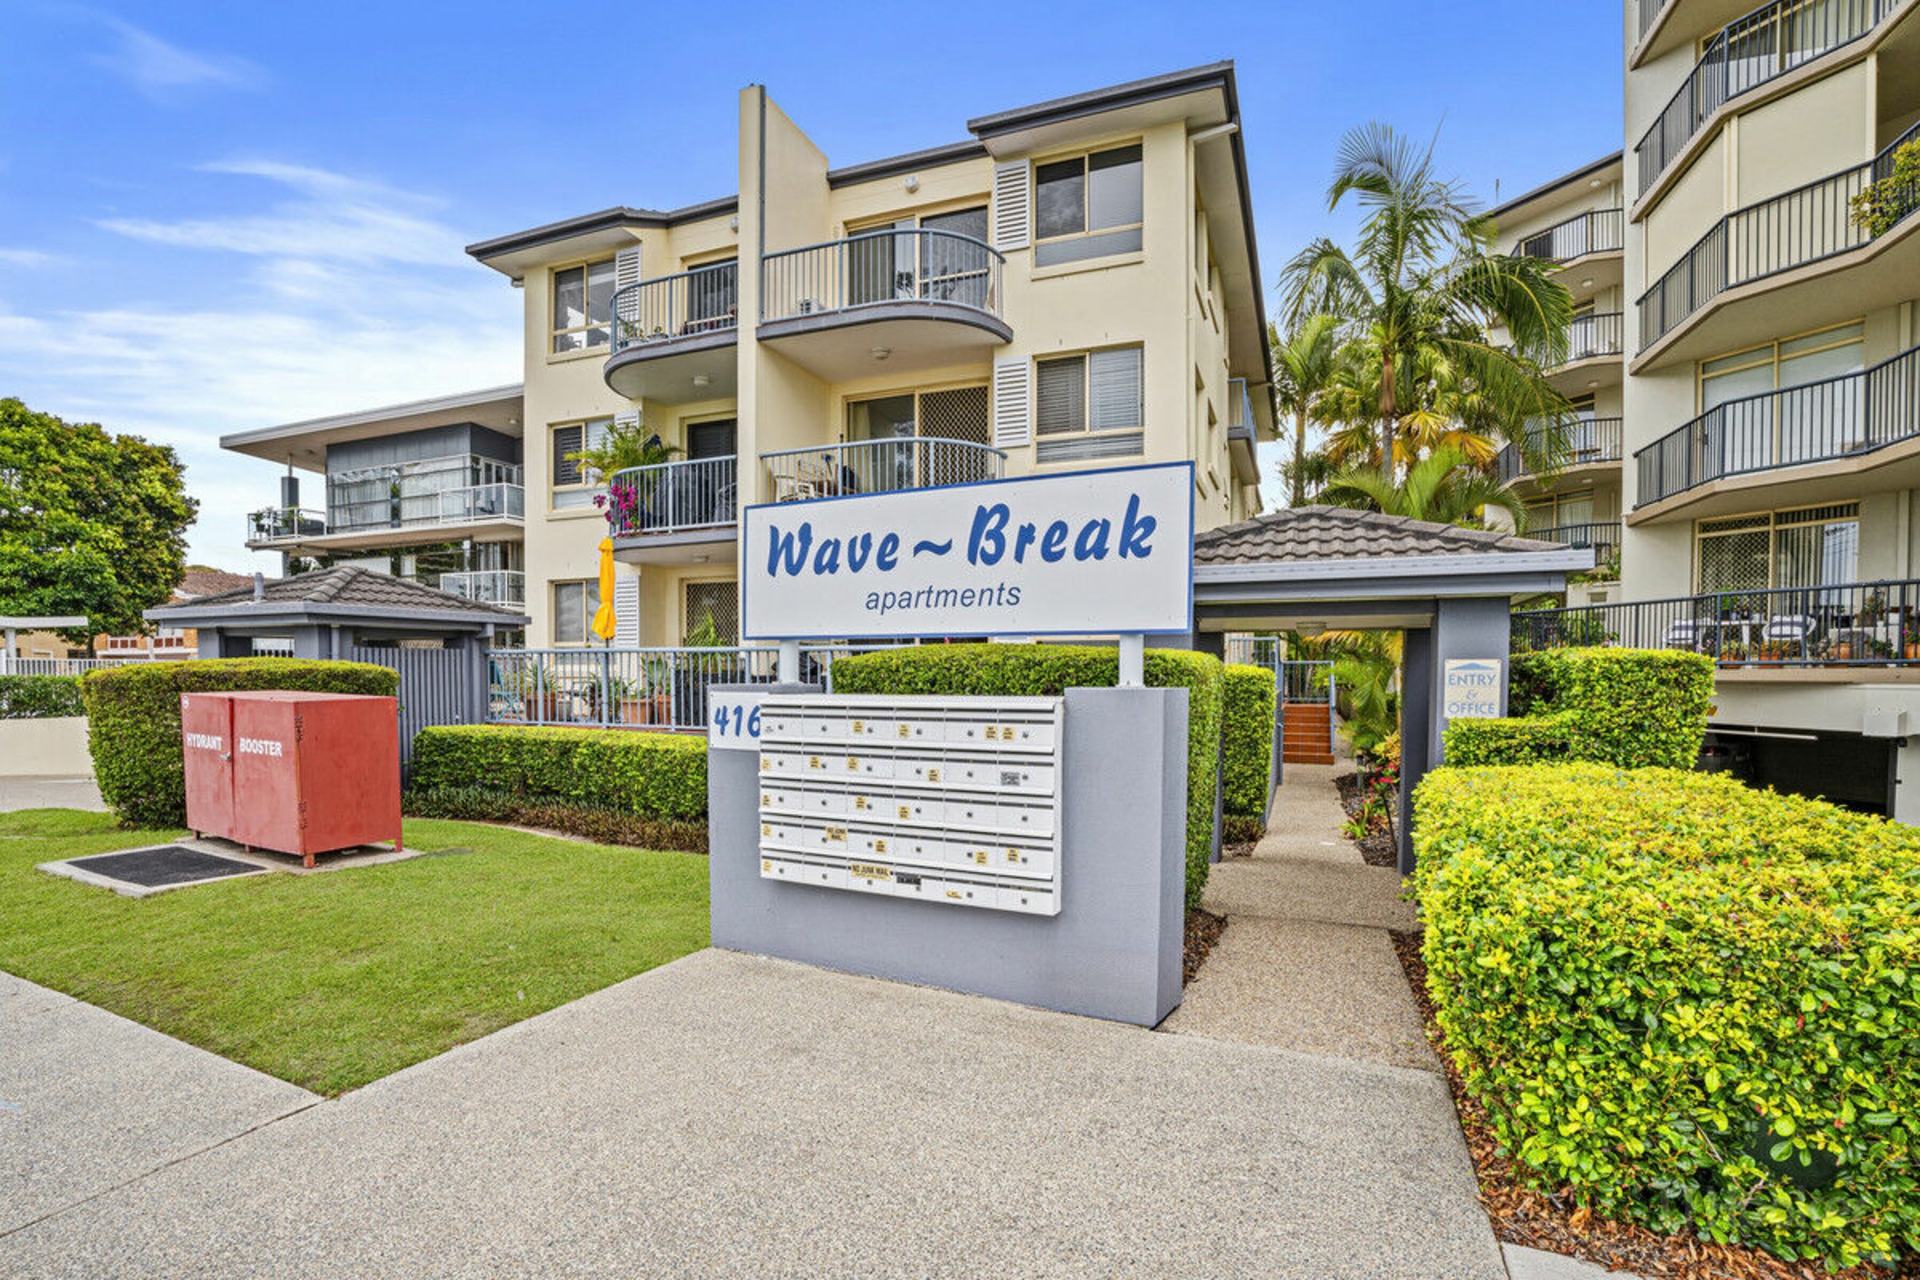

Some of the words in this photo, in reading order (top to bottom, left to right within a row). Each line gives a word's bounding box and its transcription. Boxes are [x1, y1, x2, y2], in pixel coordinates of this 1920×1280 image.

[767, 522, 900, 578] Wave
[967, 493, 1158, 566] Break
[865, 583, 1022, 615] apartments
[1448, 673, 1496, 686] ENTRY
[714, 705, 760, 738] 416
[1448, 702, 1495, 715] OFFICE
[186, 732, 222, 751] HYDRANT
[240, 737, 282, 757] BOOSTER
